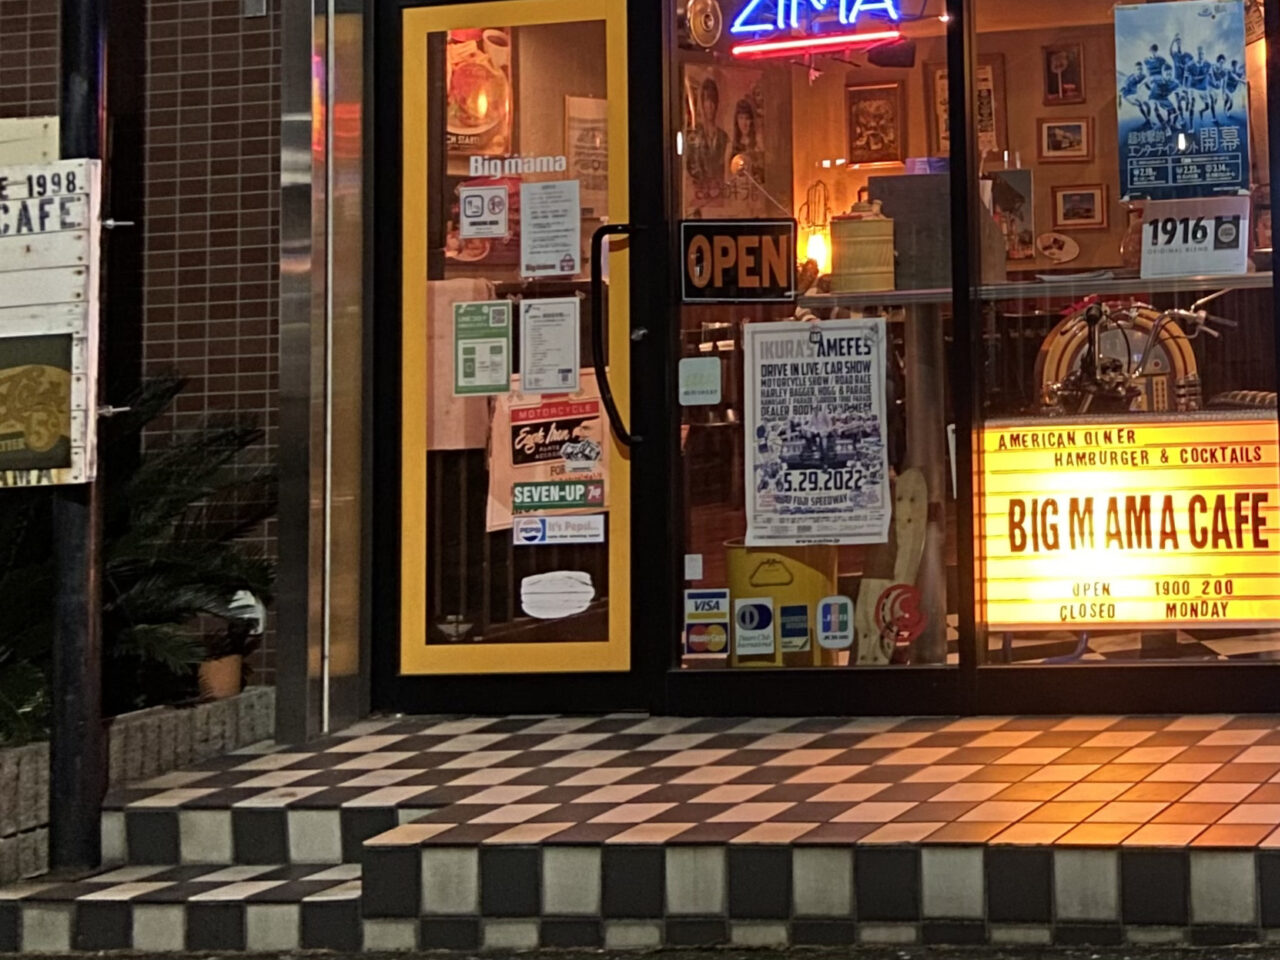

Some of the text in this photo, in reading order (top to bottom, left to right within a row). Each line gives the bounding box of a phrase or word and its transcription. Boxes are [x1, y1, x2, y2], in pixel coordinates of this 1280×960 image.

[1199, 126, 1240, 152] 開幕
[27, 171, 76, 198] 1998
[1149, 216, 1208, 246] 1916
[688, 235, 791, 288] OPEN
[761, 363, 788, 378] DRIVE
[790, 362, 800, 376] IN
[518, 404, 592, 418] MOTORCYCLE
[999, 429, 1136, 450] AMERICAN DINER
[1055, 446, 1262, 467] HAMBURGER & COCKTAILS
[784, 470, 862, 492] 5.29.2022
[514, 485, 585, 503] SEVEN-UP
[1008, 498, 1060, 553] BIG
[1188, 492, 1269, 549] CAFE
[1073, 580, 1233, 597] OPEN 1900 200
[694, 600, 720, 611] VISA
[1060, 601, 1229, 621] CLOSED MONDAY
